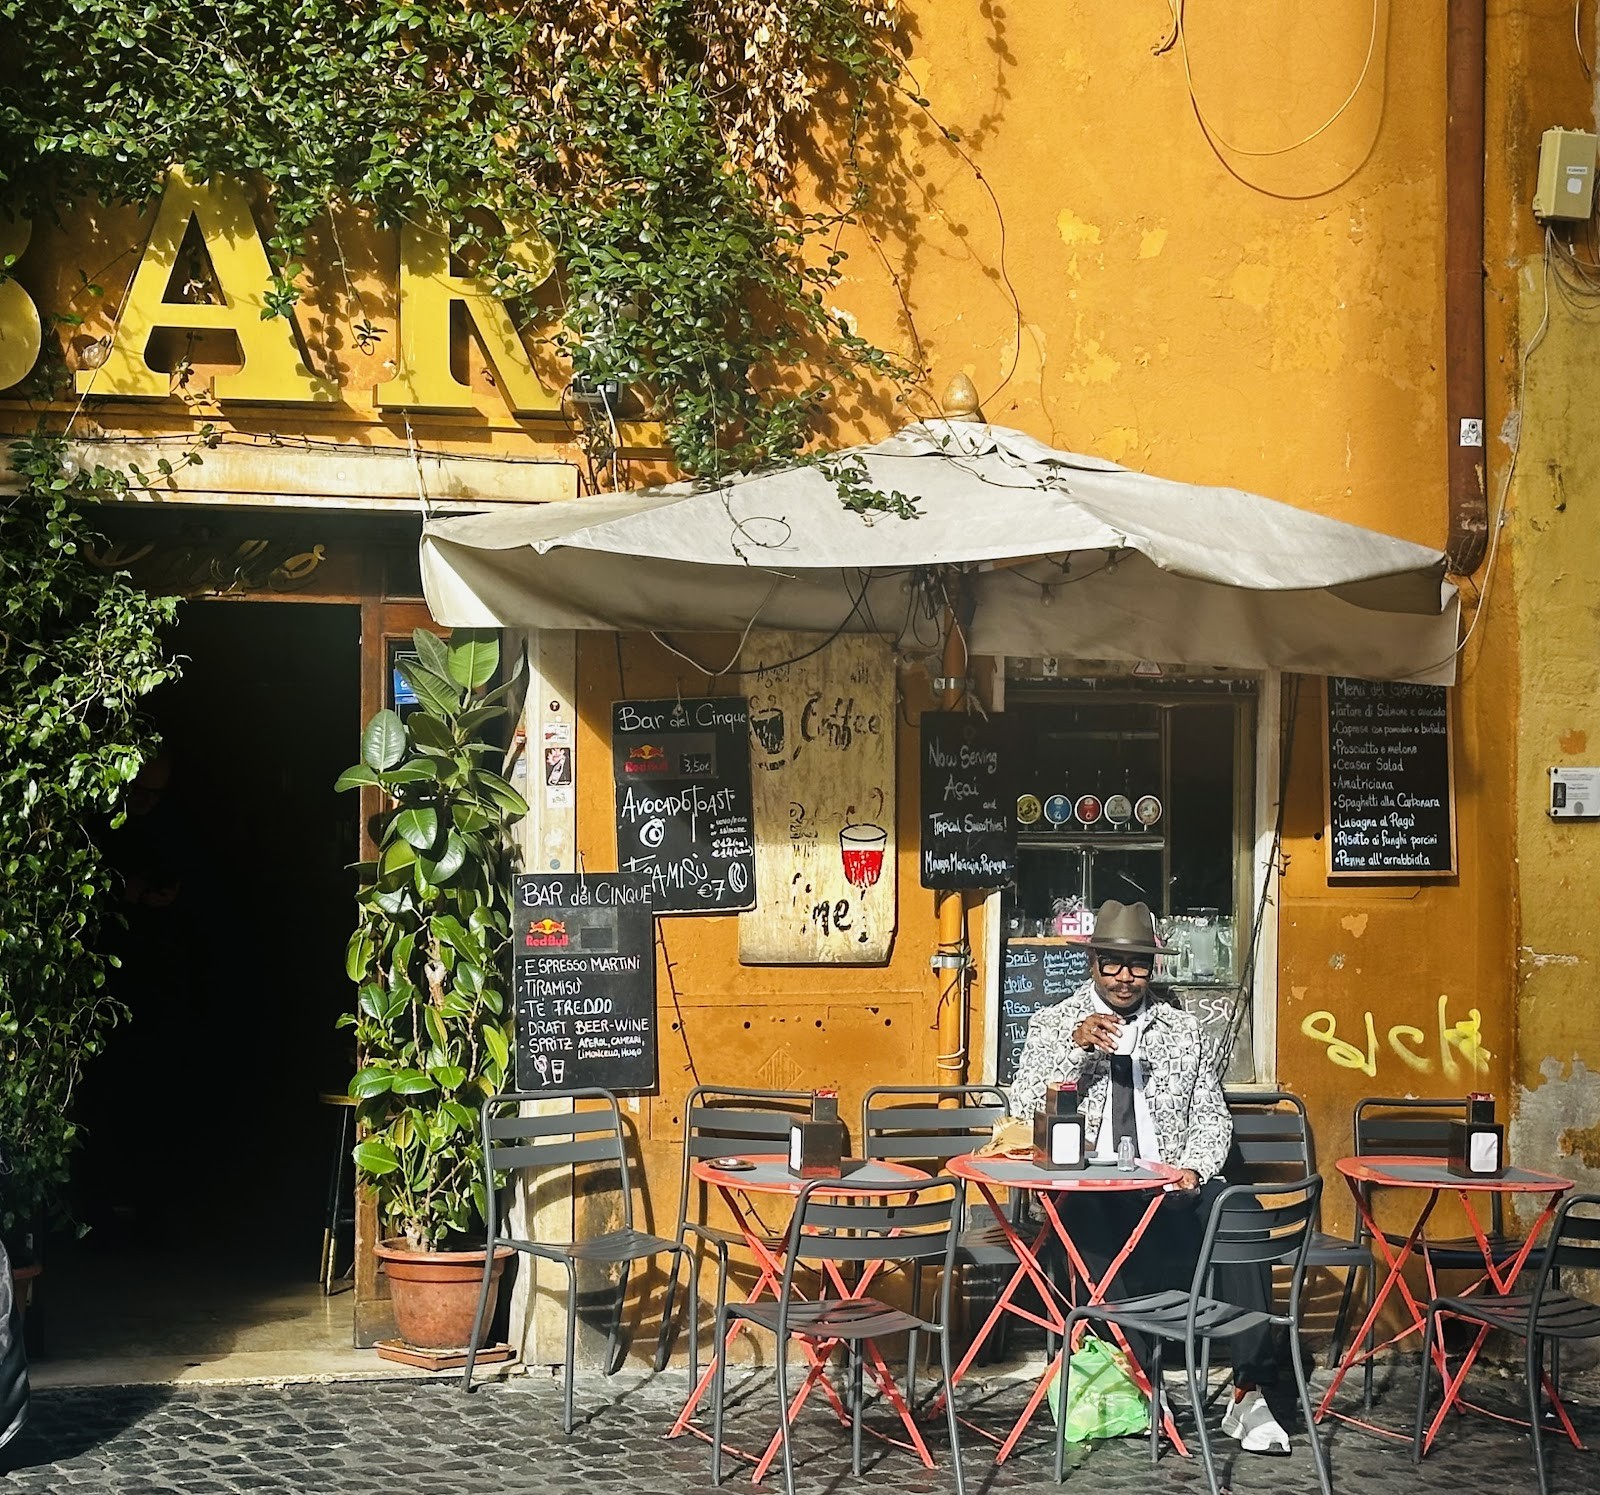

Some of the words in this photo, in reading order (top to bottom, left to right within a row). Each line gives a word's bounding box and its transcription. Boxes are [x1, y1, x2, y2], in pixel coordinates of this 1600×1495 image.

[0, 163, 565, 411] AR
[618, 706, 664, 731] Bar
[670, 710, 690, 728] del
[696, 703, 746, 733] Cinque
[1365, 704, 1373, 717] di
[1335, 720, 1369, 737] Caprese
[928, 736, 957, 768] Now
[960, 745, 998, 774] Serving
[1380, 746, 1386, 754] e
[1387, 741, 1418, 754] melone
[1337, 759, 1371, 771] Ceasar
[1376, 757, 1404, 772] Salad
[1337, 775, 1394, 790] Amatriciana
[983, 799, 997, 809] and
[1338, 793, 1378, 812] Spaghetti
[1380, 795, 1395, 807] alla
[1397, 792, 1440, 808] Carbonara
[929, 812, 962, 838] Tropical
[1338, 813, 1377, 831] Lasagna
[1380, 815, 1388, 827] al
[1389, 812, 1415, 829] Ragù
[1337, 830, 1369, 847] Risotto
[1372, 834, 1380, 846] ai
[1381, 829, 1407, 849] funghi
[1410, 834, 1438, 850] porcini
[1337, 849, 1365, 866] Penne
[1383, 852, 1430, 866] arrabbiata
[521, 881, 563, 906] BAR
[570, 883, 591, 906] del
[595, 882, 652, 905] CINQUE
[697, 880, 726, 901] €7
[526, 934, 547, 946] Red
[1006, 949, 1038, 965] Spritz
[525, 958, 587, 976] ESPRESSO
[1004, 974, 1033, 991] Mojito
[553, 997, 612, 1016] FREDDO
[528, 1020, 566, 1036] DRAFT
